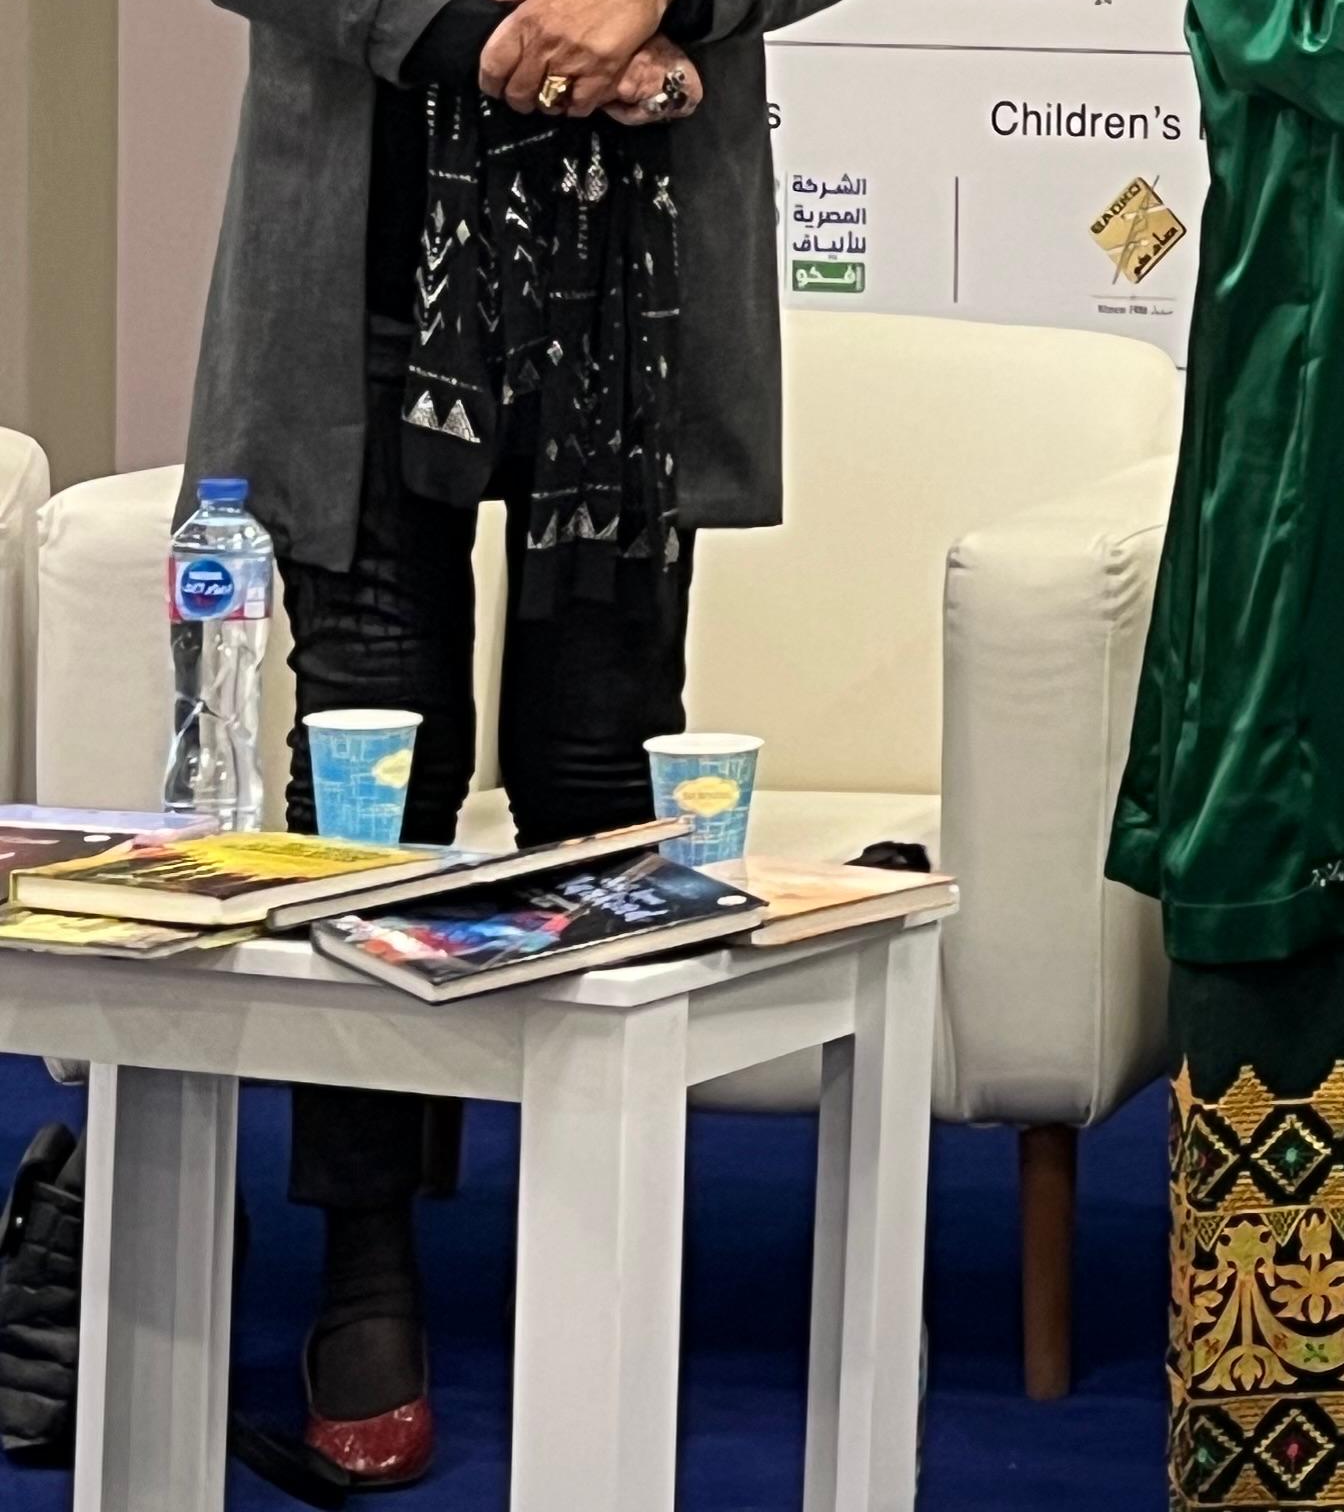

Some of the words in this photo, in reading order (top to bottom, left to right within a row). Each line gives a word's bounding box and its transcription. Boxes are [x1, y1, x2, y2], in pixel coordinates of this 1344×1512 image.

[991, 100, 1181, 140] Children's
[792, 173, 867, 199] الشركة
[793, 204, 867, 229] المصرية
